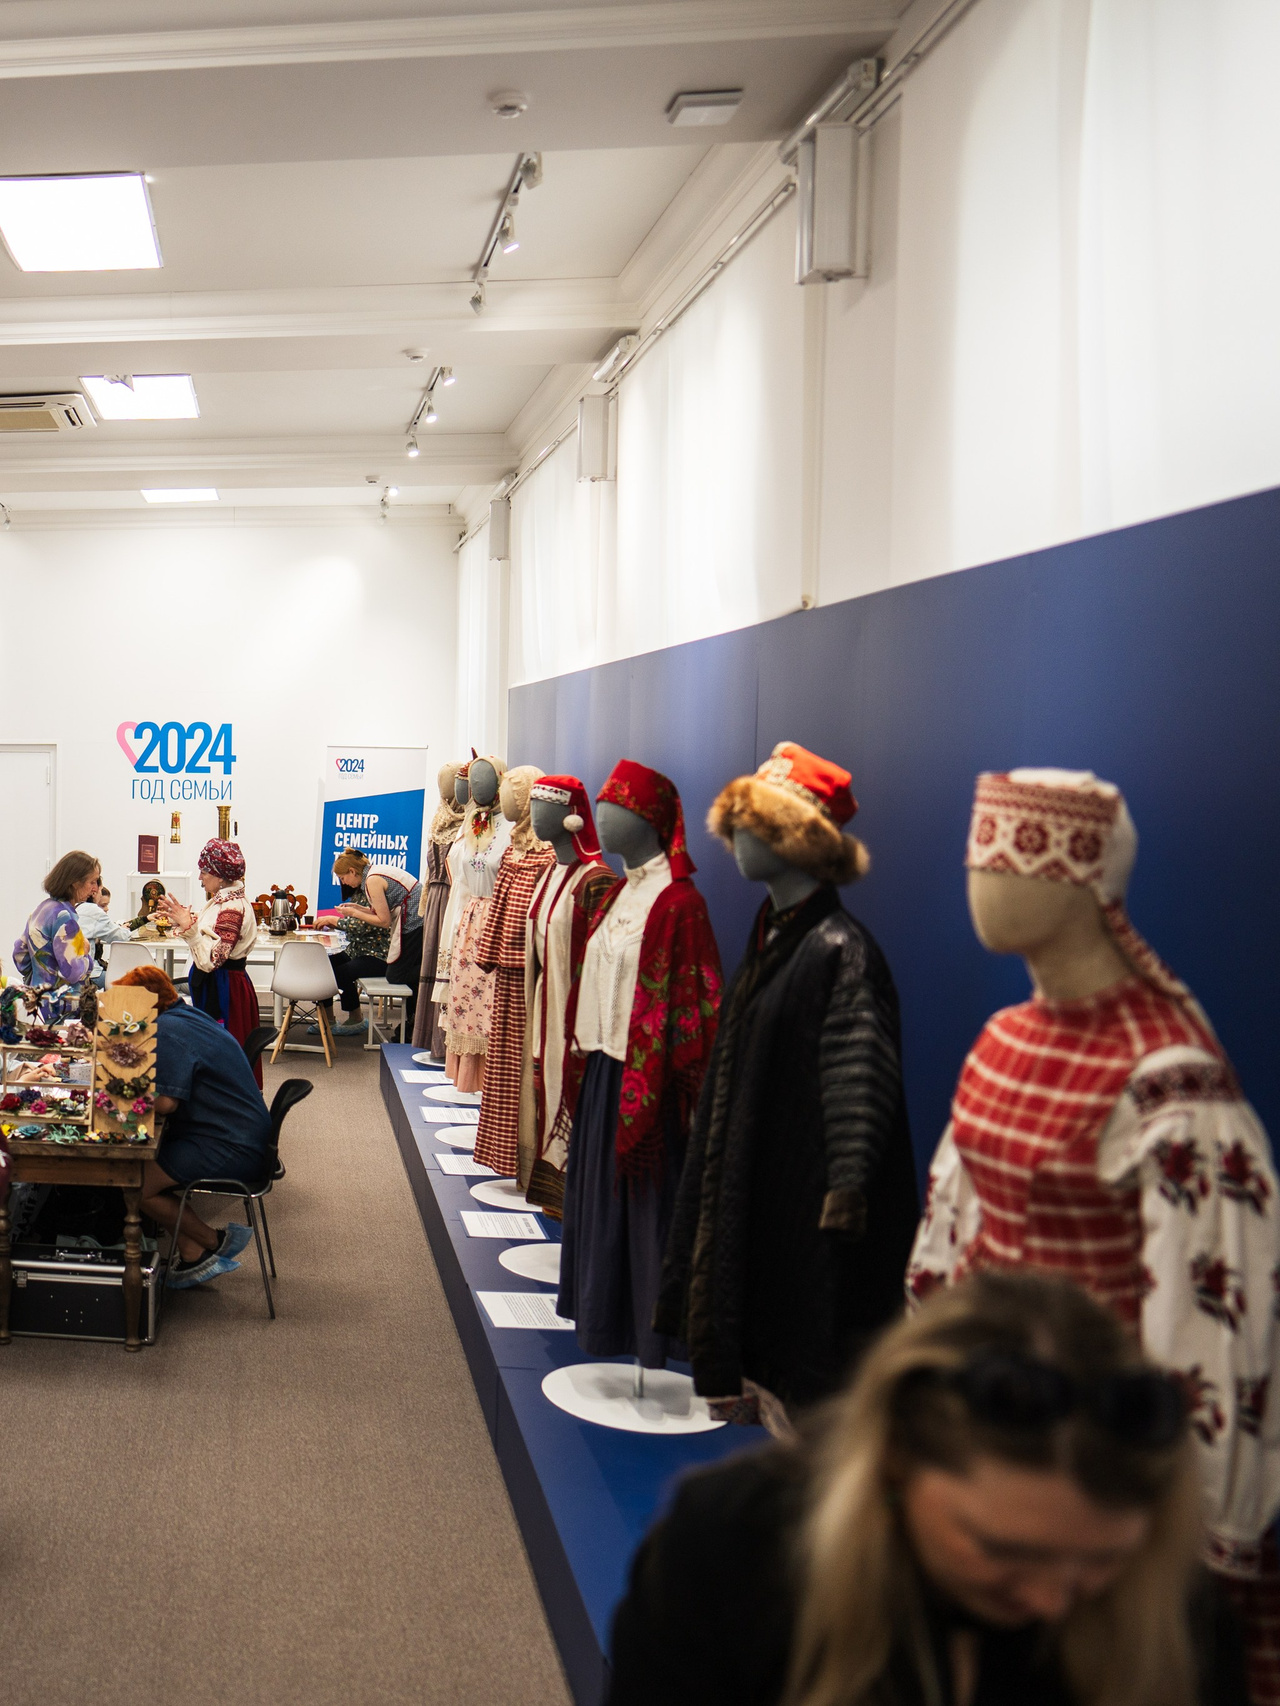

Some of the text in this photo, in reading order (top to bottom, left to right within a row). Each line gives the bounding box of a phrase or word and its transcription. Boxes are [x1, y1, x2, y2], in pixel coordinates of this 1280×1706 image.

[134, 722, 236, 774] 2024
[340, 758, 364, 772] 2024
[336, 813, 378, 830] ЦЕНТР
[334, 830, 408, 850] СЕМЕЙНЫХ
